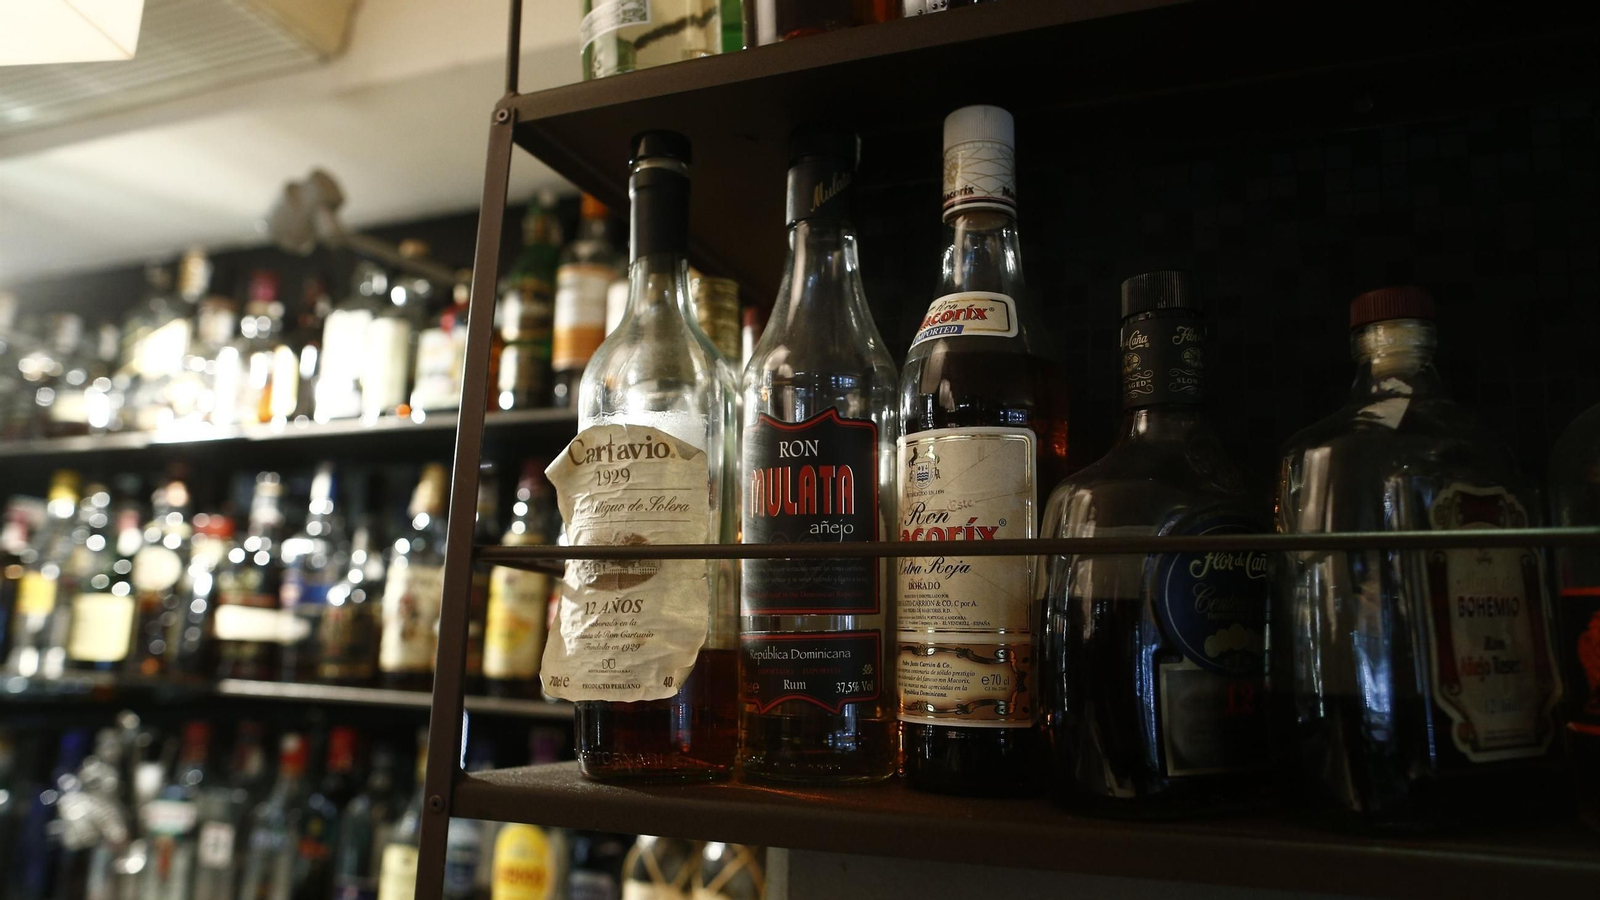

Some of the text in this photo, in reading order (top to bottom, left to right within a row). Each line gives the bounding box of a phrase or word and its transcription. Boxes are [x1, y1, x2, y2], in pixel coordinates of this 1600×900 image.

[943, 184, 974, 200] acoríx
[779, 440, 819, 458] RON
[596, 468, 631, 487] 1929
[751, 464, 855, 518] MULATA
[627, 497, 645, 513] de
[644, 495, 691, 513] Solera
[904, 502, 951, 526] Ron
[809, 518, 855, 542] añejo
[924, 555, 972, 580] Roja
[1245, 551, 1268, 579] Cañ
[908, 580, 941, 591] DORADO
[584, 596, 644, 616] 12 AÑOS
[1457, 595, 1520, 618] BOHEMIO
[621, 643, 642, 652] 1929
[749, 645, 852, 666] República Dominicana
[783, 678, 807, 690] Rum
[835, 680, 874, 695] 37,5% Vol
[1003, 675, 1010, 686] cl
